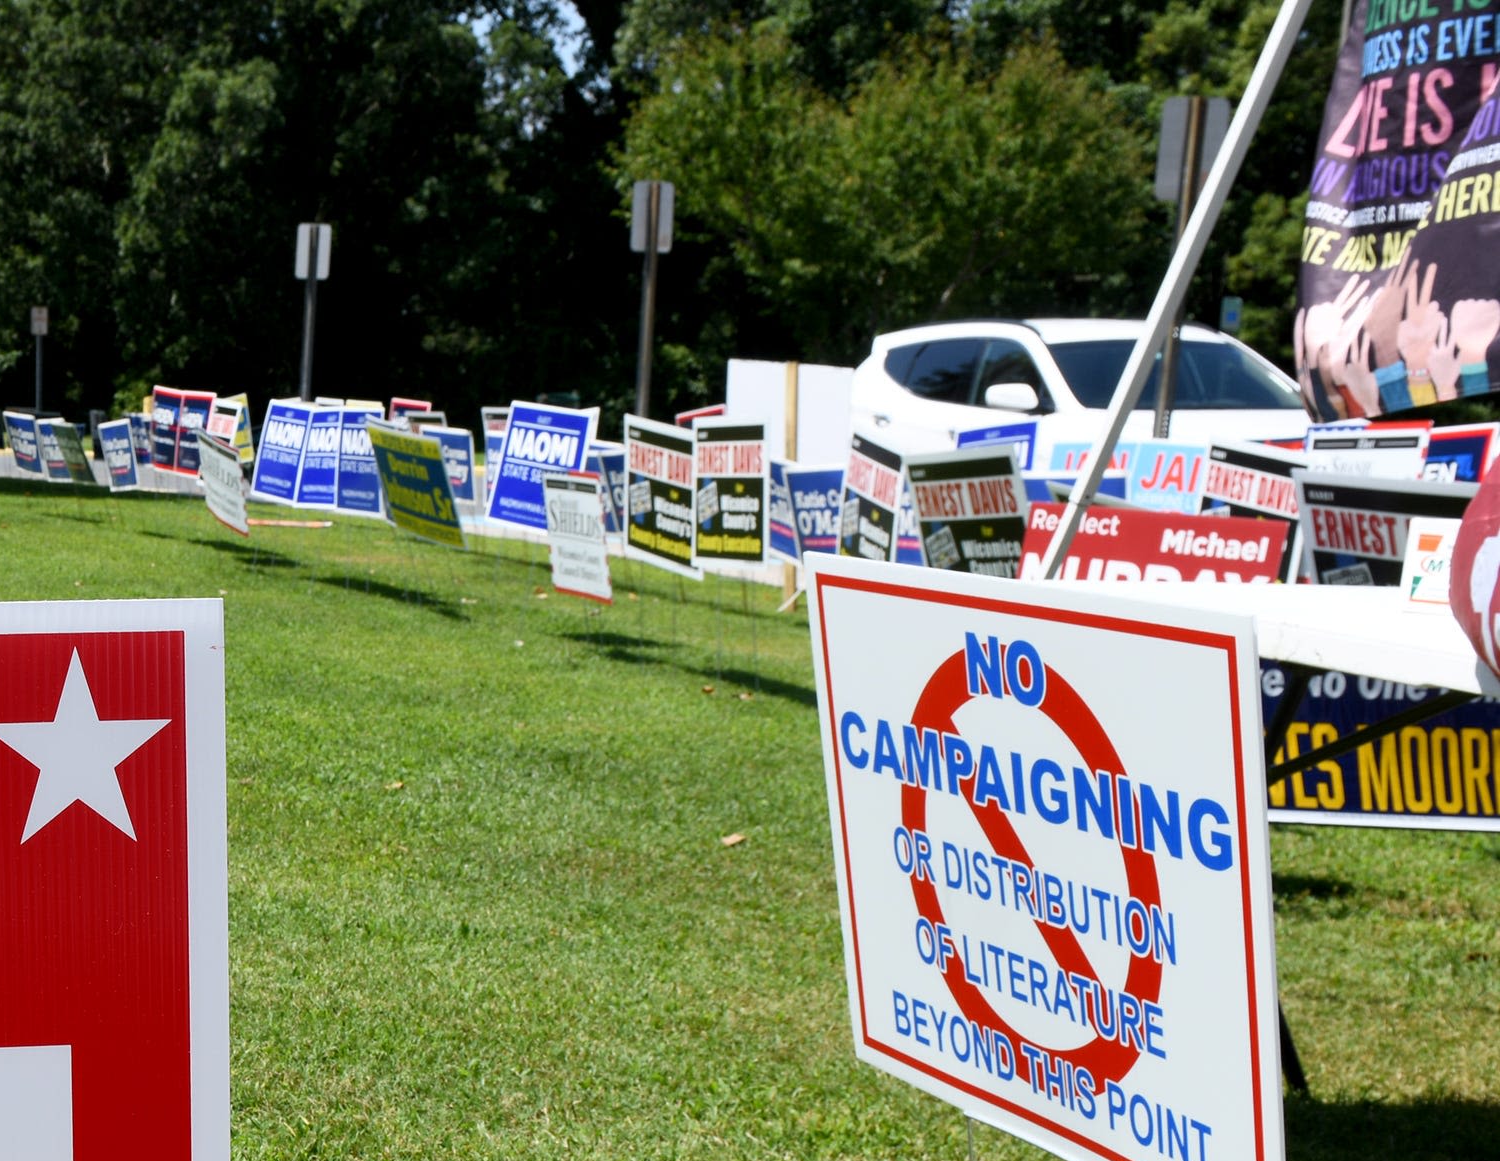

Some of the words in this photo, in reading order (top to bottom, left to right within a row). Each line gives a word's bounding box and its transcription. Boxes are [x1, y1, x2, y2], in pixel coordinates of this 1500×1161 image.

[1406, 23, 1431, 66] IS
[1435, 14, 1500, 62] EVE
[1403, 67, 1455, 148] IS
[263, 419, 306, 450] NAOMI
[506, 426, 579, 469] NAOMI
[501, 462, 530, 482] STATE
[1140, 452, 1202, 494] JAI
[1206, 464, 1255, 502] ERNEST
[915, 482, 966, 518] ERNEST
[966, 477, 1018, 516] DAVIS
[1158, 527, 1270, 564] Michael
[1311, 507, 1399, 557] ERNEST
[964, 631, 1047, 709] NO
[839, 709, 1235, 873] CAMPAIGNING
[893, 825, 937, 882] OR
[942, 840, 1178, 966] DISTRIBUTION
[914, 916, 954, 970] OF
[962, 933, 1169, 1060] LITERATURE
[891, 990, 1017, 1083] BEYOND
[1022, 1042, 1099, 1121] THIS
